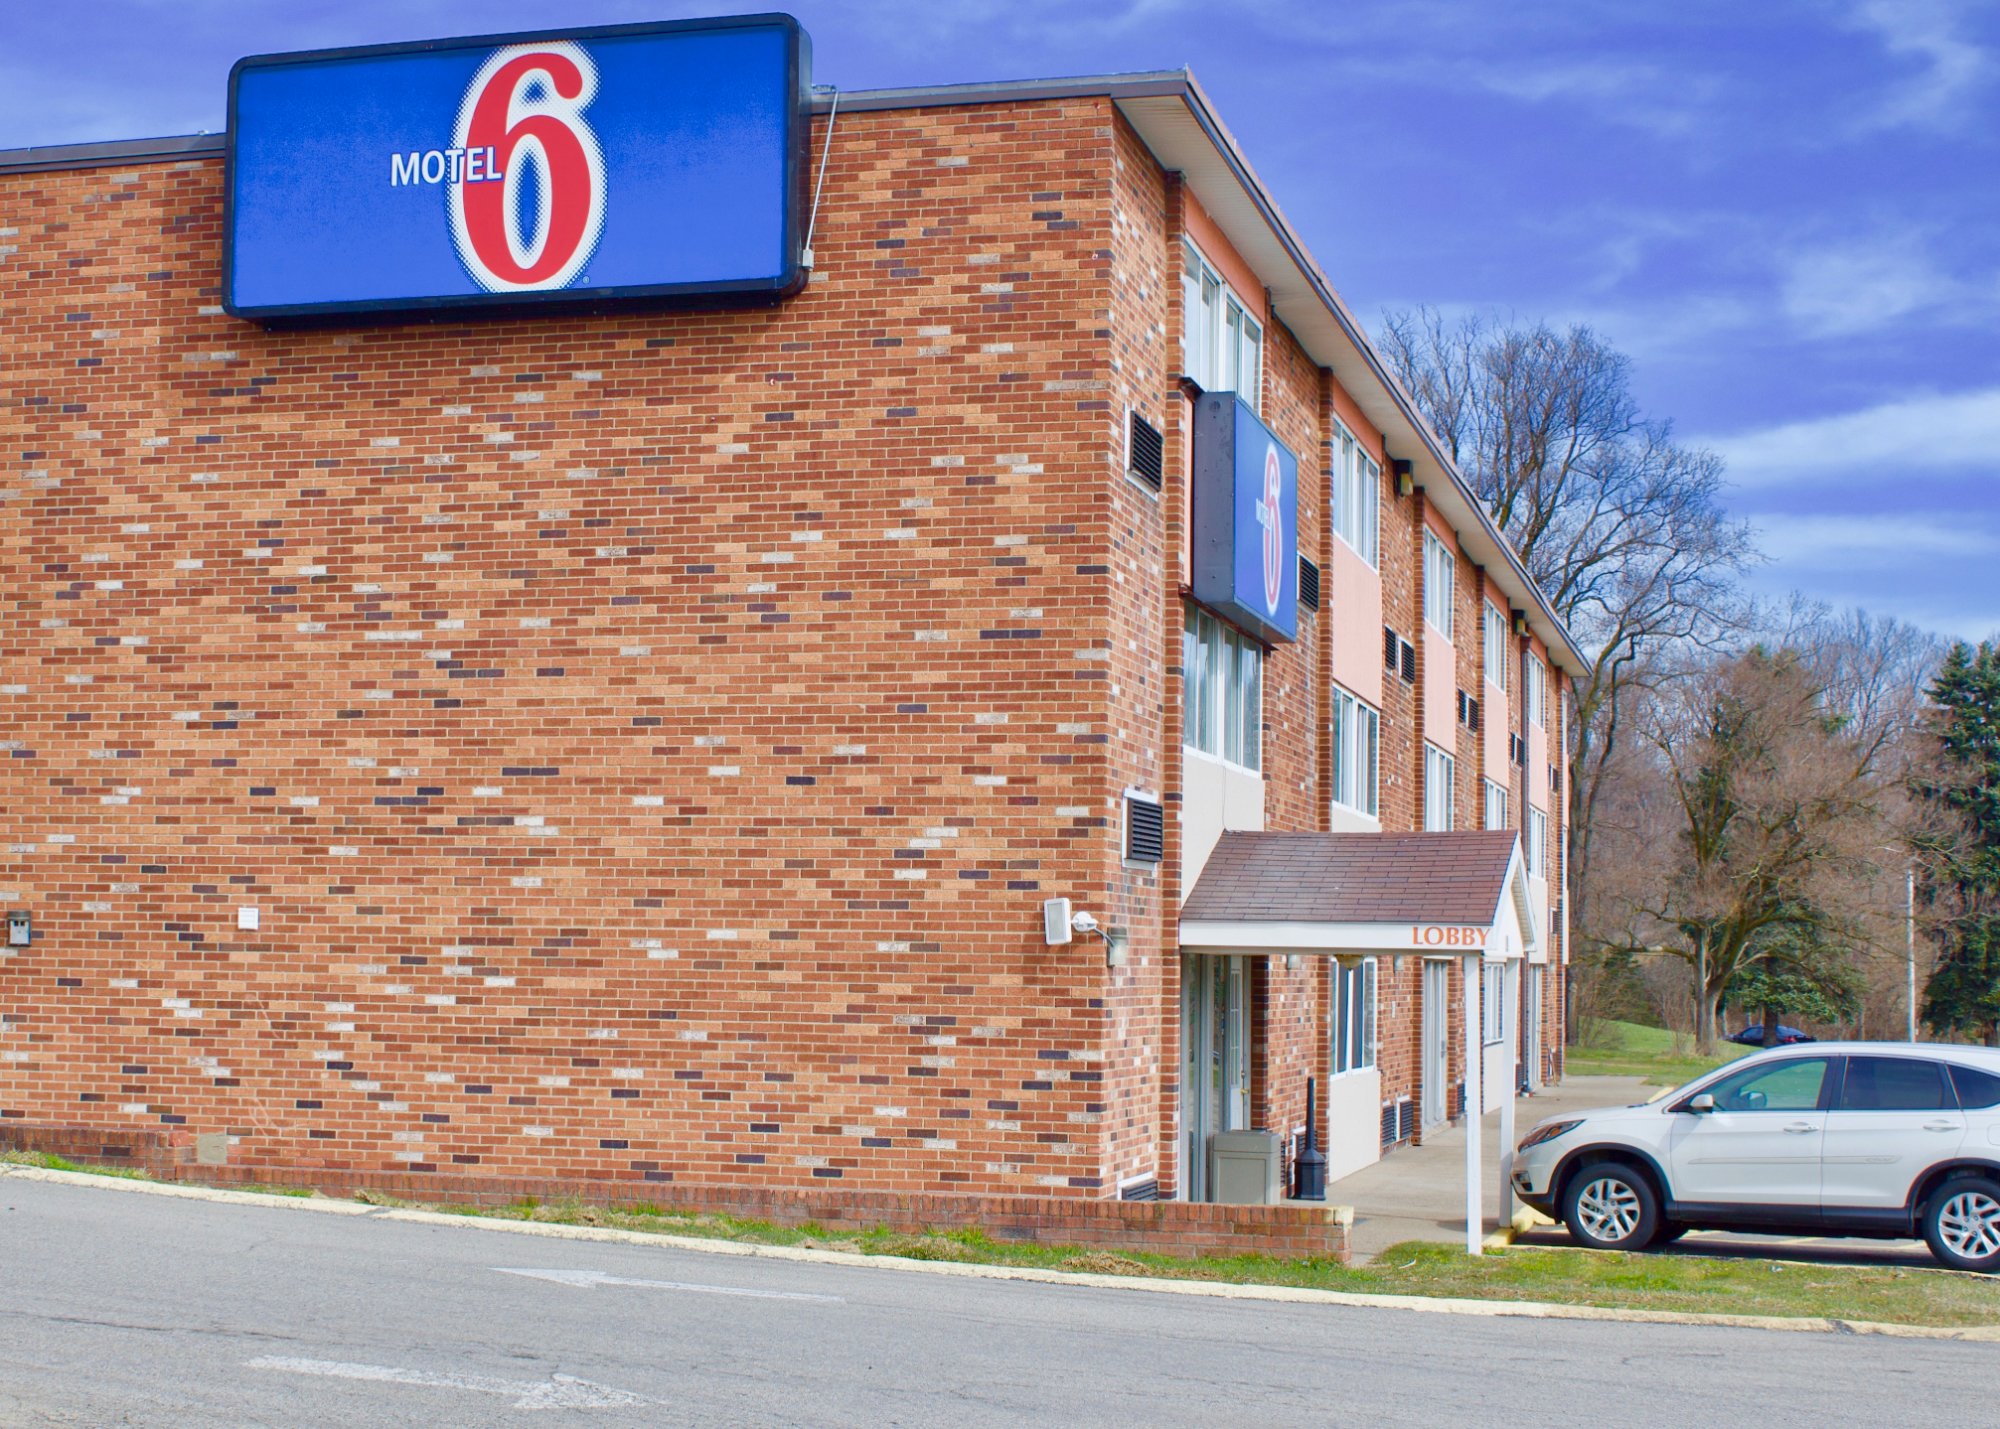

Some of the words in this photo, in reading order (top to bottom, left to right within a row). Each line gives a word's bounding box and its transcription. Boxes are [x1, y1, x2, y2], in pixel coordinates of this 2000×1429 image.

[390, 146, 503, 187] MOTEL
[461, 51, 592, 285] 6
[1264, 448, 1281, 609] 6
[1412, 926, 1490, 946] LOBBY
